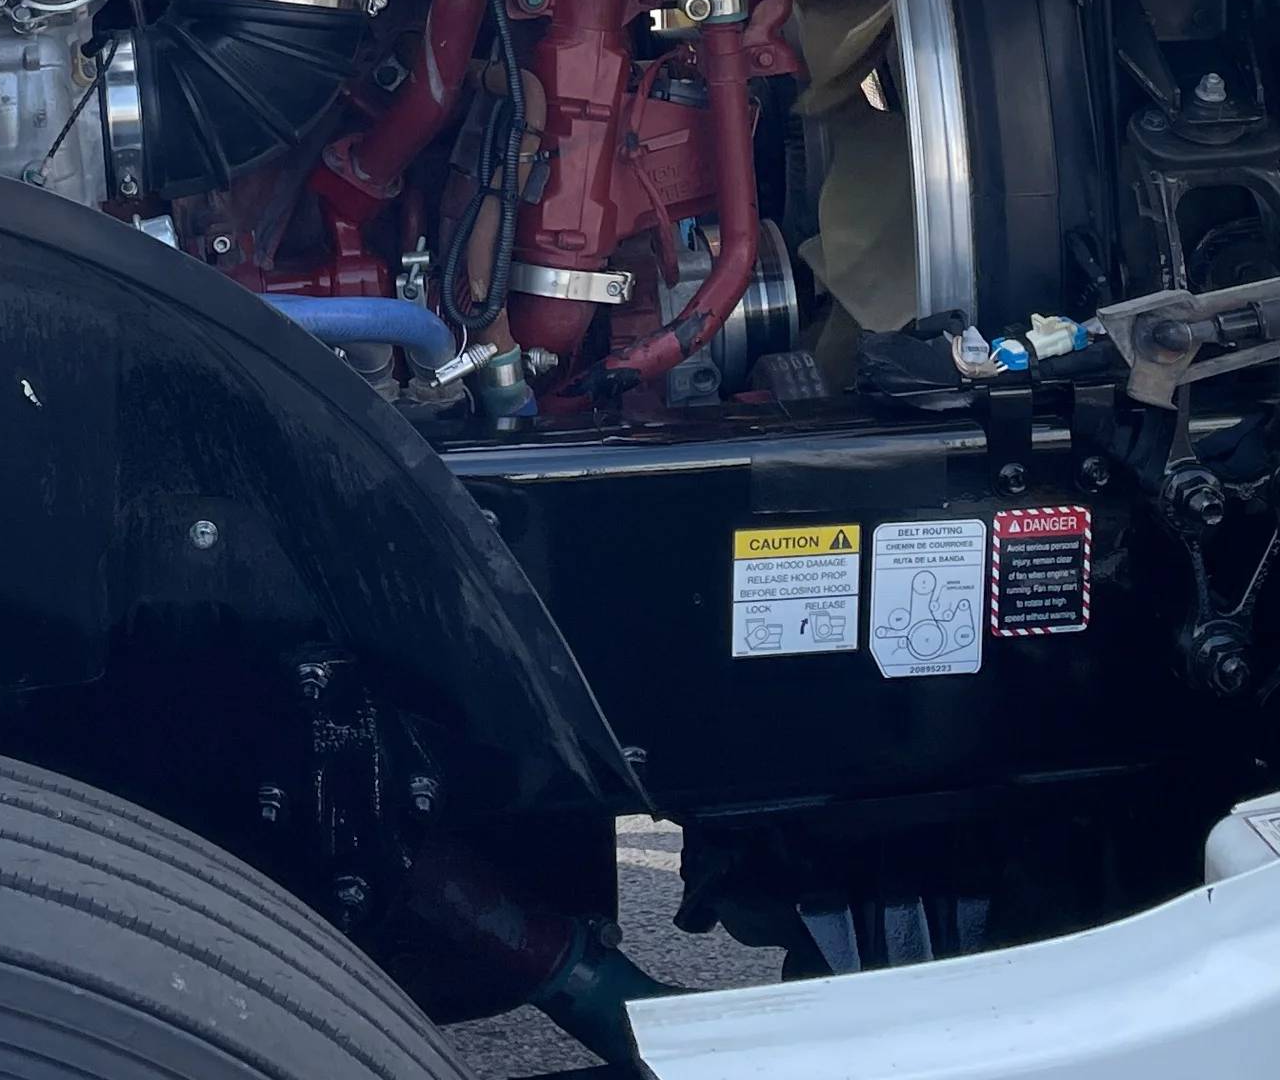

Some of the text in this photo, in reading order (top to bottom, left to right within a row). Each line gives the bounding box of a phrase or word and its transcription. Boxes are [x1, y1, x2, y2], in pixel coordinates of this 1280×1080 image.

[1023, 516, 1077, 532] DANGER
[898, 526, 963, 536] BELT ROUTING
[749, 535, 820, 551] CAUTION
[885, 543, 915, 551] CHEMIN
[917, 542, 928, 550] DE
[1007, 541, 1079, 553] Avoid serious personal
[746, 562, 774, 571] AVOID
[776, 560, 804, 569] HOOD
[893, 555, 965, 565] RUTA DE LA BANDA
[1033, 557, 1055, 565] remain
[1056, 556, 1073, 564] clear
[747, 570, 847, 585] RELEASE HOOD PROP
[1008, 572, 1015, 581] of
[1016, 571, 1027, 580] fan
[1028, 571, 1046, 579] when
[1047, 569, 1068, 579] engine
[740, 587, 777, 598] BEFORE
[780, 585, 821, 596] CLOSING
[1033, 584, 1046, 593] Fan
[1047, 585, 1062, 593] may
[1062, 582, 1078, 592] start
[746, 599, 846, 614] LOCK RELEASE
[1016, 599, 1024, 608] to
[1044, 598, 1052, 606] at
[1052, 597, 1067, 607] high
[1004, 614, 1025, 623] speed
[1026, 611, 1049, 621] without
